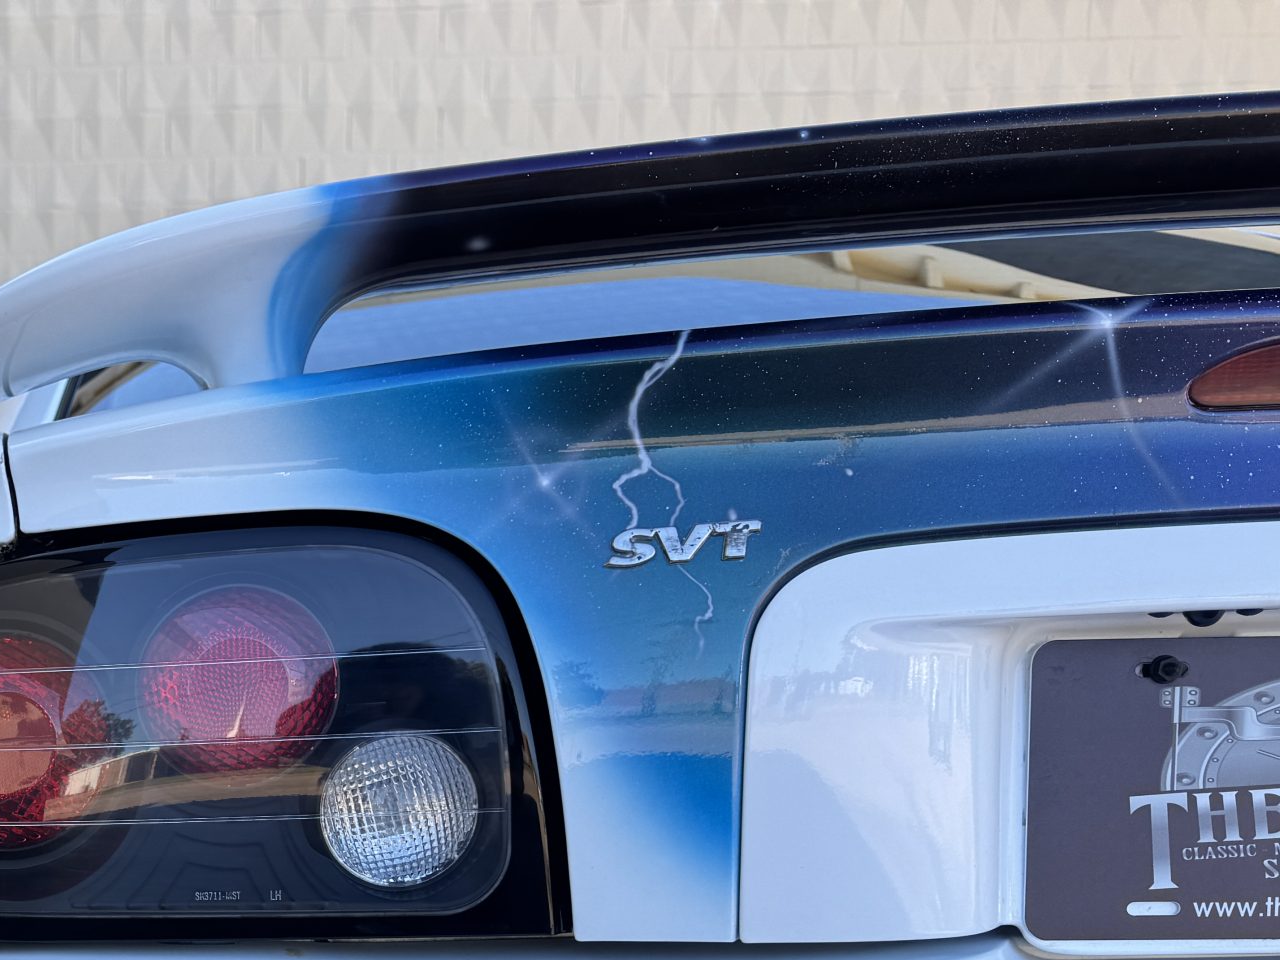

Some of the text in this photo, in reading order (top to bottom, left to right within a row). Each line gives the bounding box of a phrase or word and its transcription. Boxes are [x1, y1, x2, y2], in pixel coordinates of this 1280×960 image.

[603, 520, 761, 568] SVT
[1182, 844, 1257, 861] CLASSIC
[270, 890, 282, 901] LH
